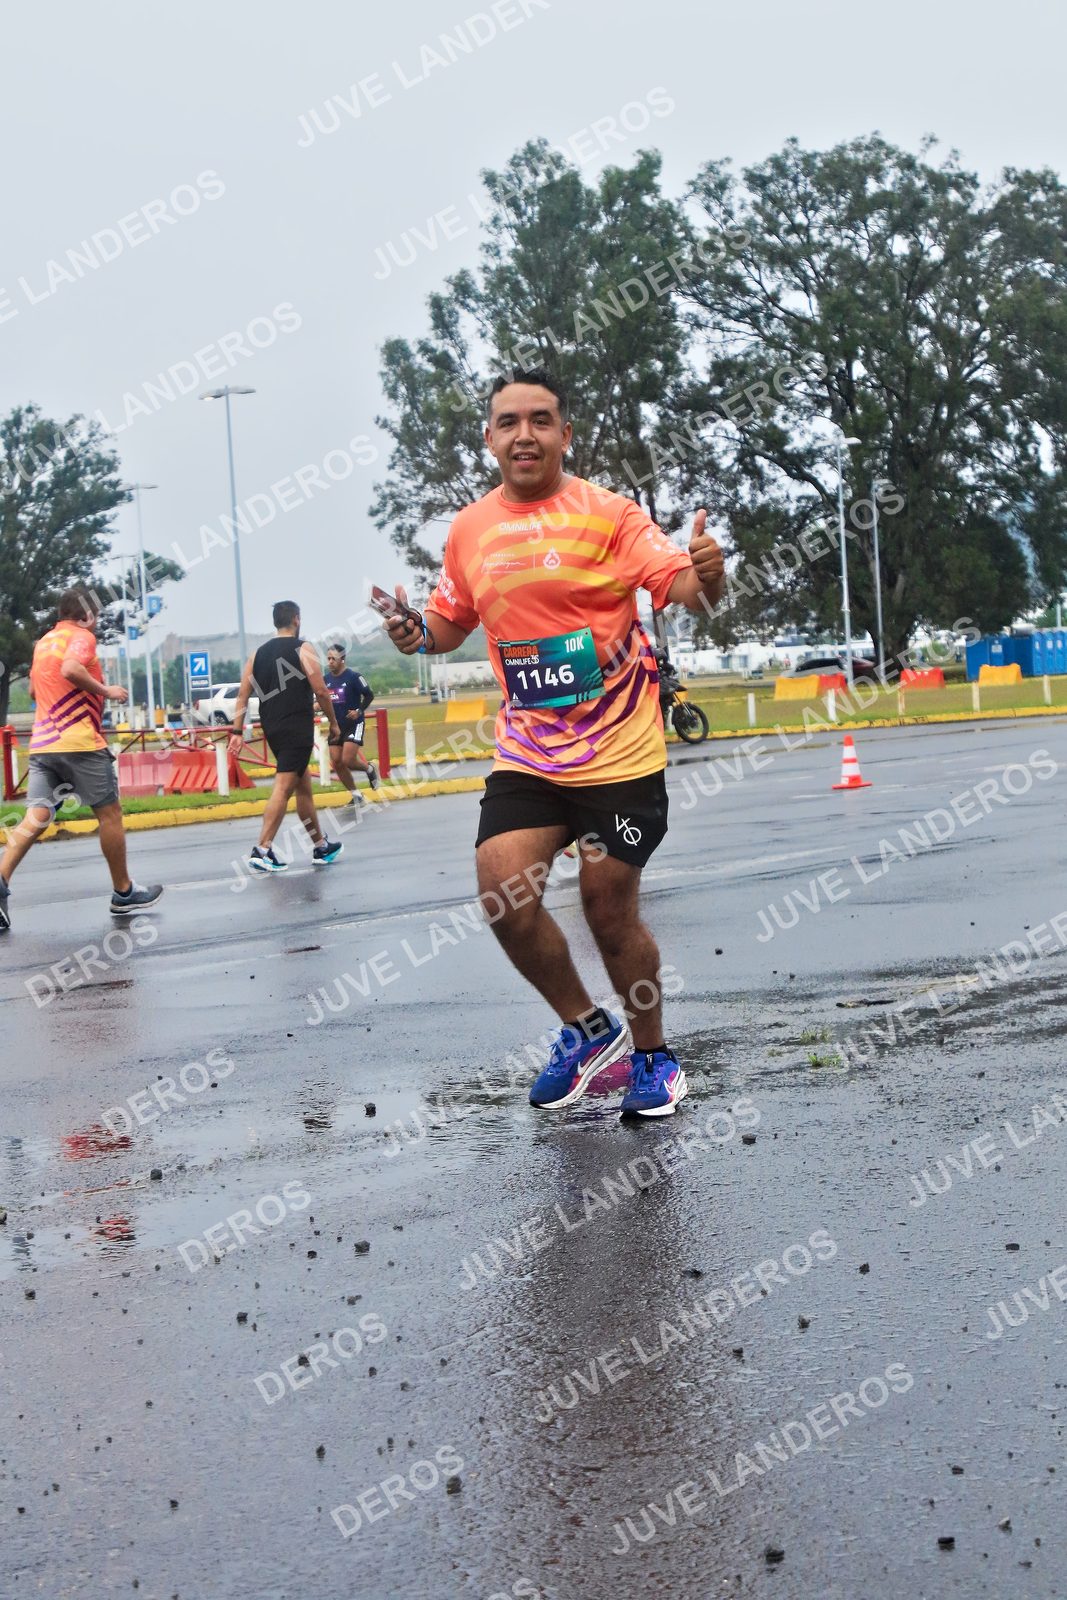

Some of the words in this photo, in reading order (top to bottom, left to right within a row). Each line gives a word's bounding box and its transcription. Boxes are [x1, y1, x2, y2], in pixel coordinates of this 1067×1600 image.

[503, 646, 539, 657] CARRERA
[565, 636, 584, 653] 10K
[517, 664, 575, 690] 1146
